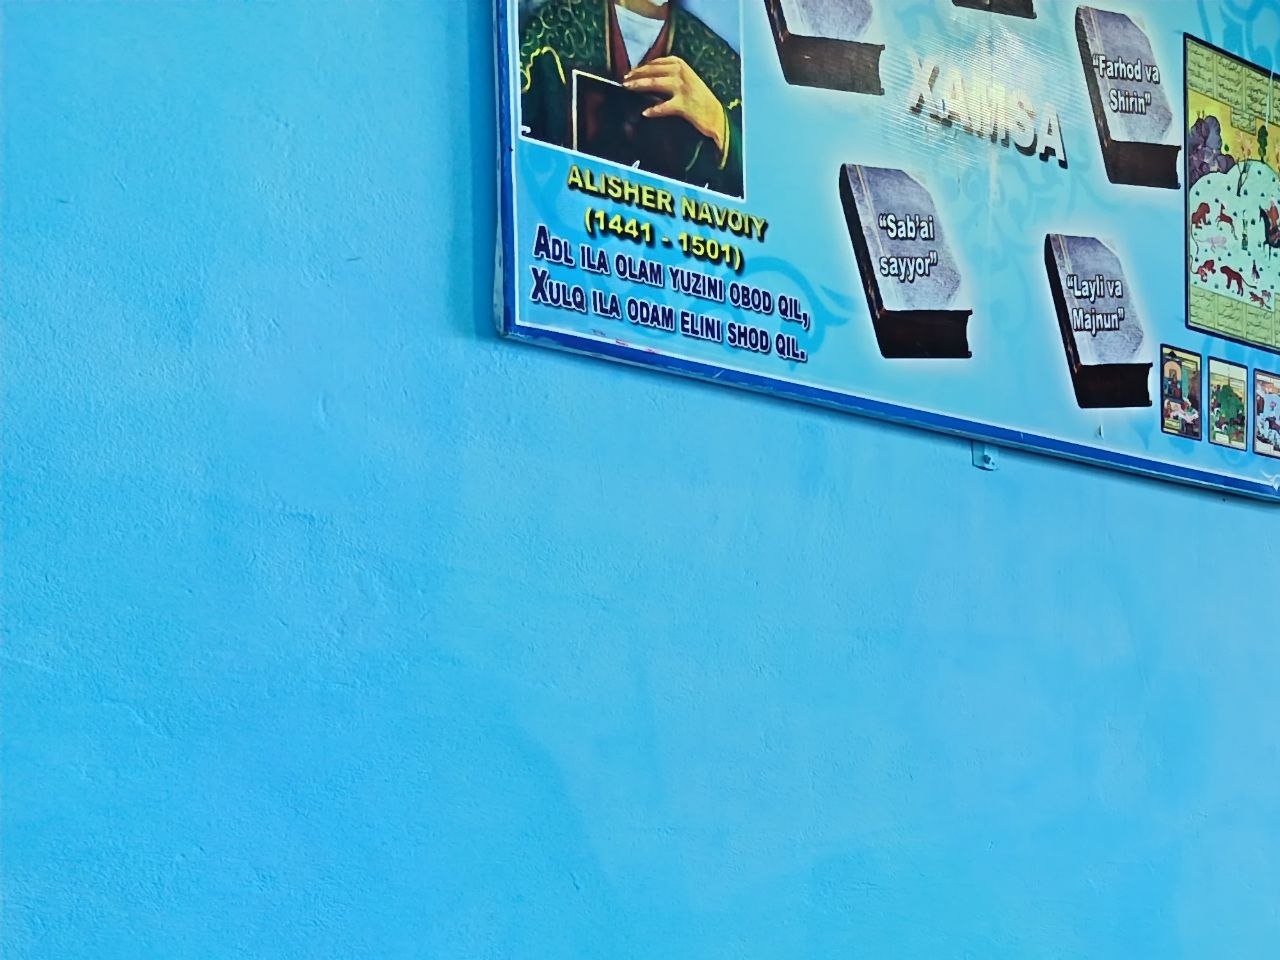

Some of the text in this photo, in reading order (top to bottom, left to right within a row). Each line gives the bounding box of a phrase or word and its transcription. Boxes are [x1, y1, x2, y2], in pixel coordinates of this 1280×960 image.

[1093, 54, 1161, 84] “Farhod va
[1109, 89, 1152, 115] Shirin”
[568, 165, 767, 239] ALISHER NAVOIY
[584, 207, 651, 242] (1441
[678, 232, 742, 271] 1501)
[533, 225, 810, 328] ADL ILA OLAM YUZINI OBOD QIL,
[880, 251, 938, 282] sayyor”
[1066, 275, 1123, 302] “Layli va
[531, 268, 807, 361] XULQ ILA ODAM ELINI SHOD QIL.
[1071, 308, 1125, 335] Majnun”
